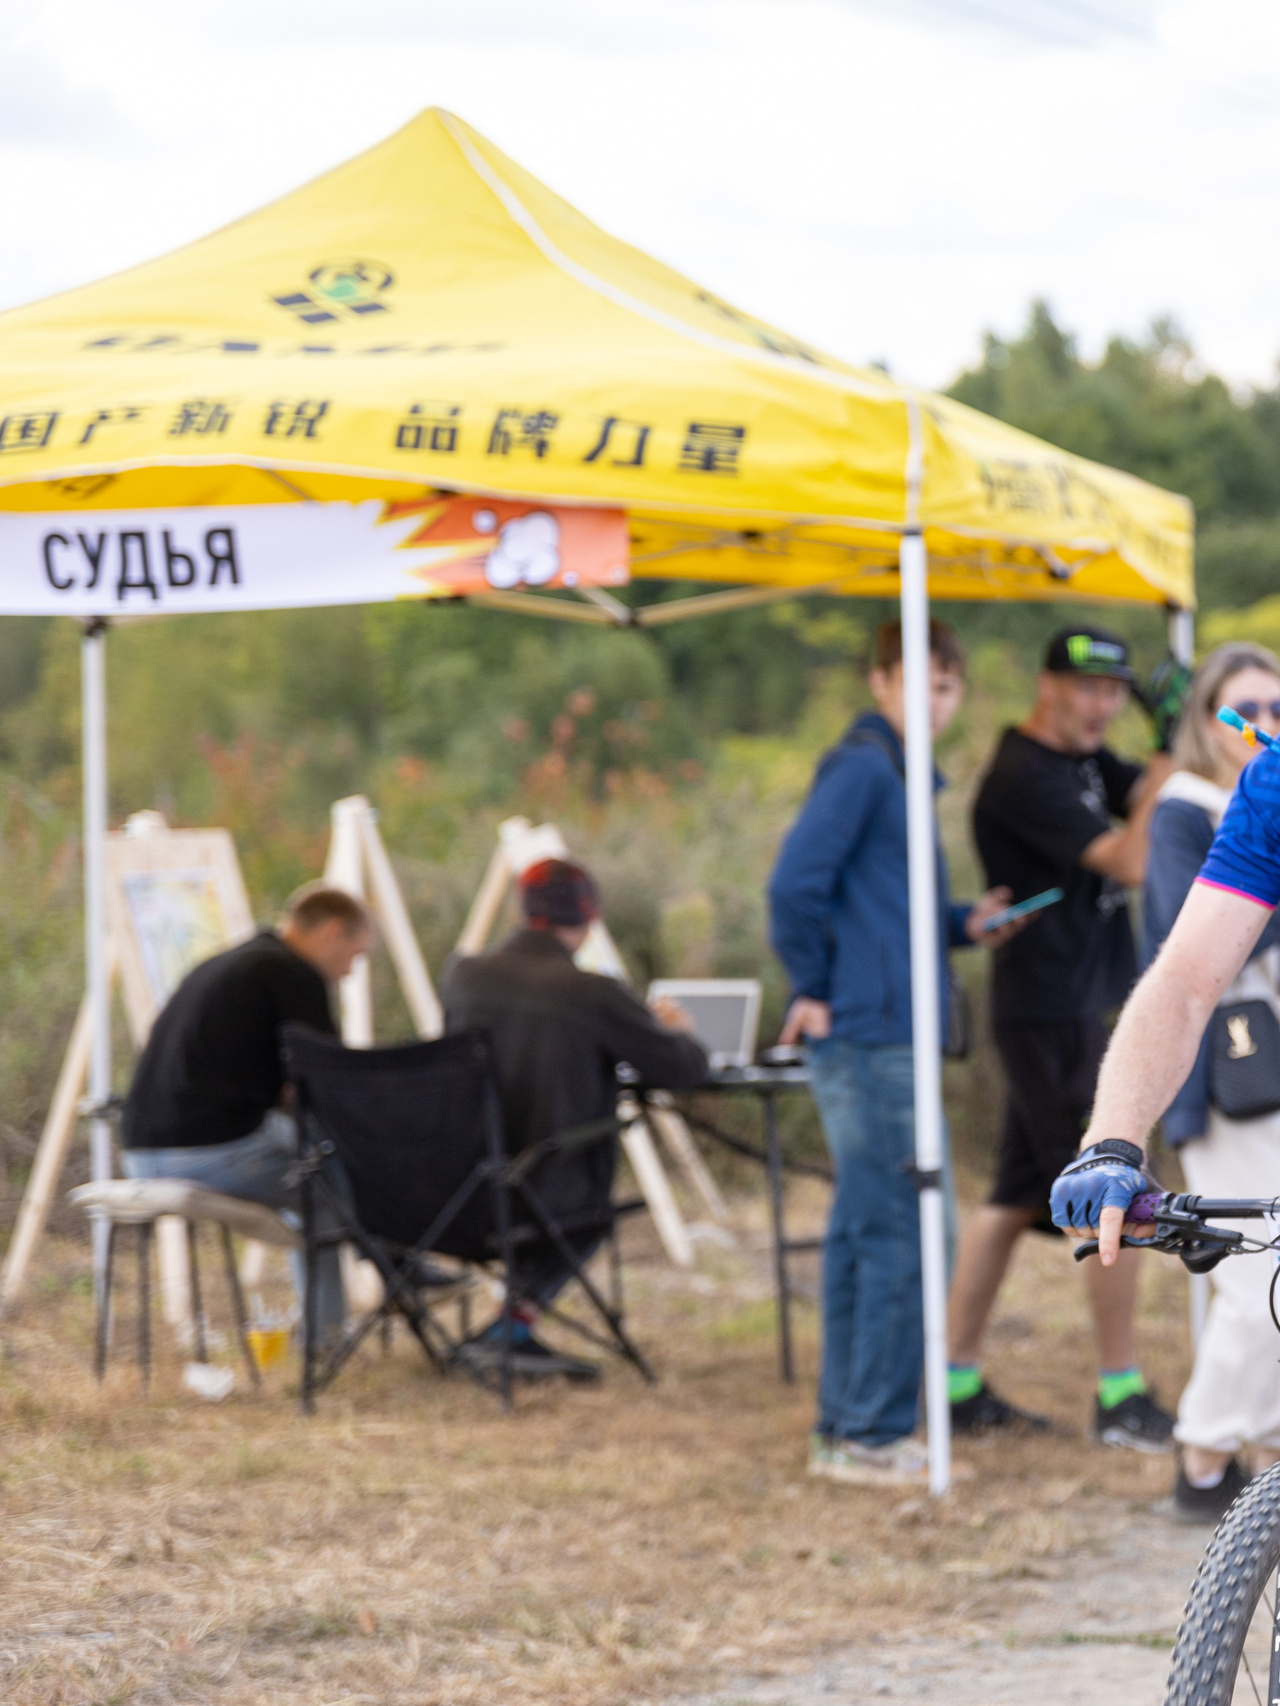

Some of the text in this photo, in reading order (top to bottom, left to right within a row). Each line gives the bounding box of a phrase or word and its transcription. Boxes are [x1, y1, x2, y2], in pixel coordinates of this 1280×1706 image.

[0, 398, 746, 474] 国产新锐 品牌力量
[43, 527, 240, 602] СУДЬЯ
